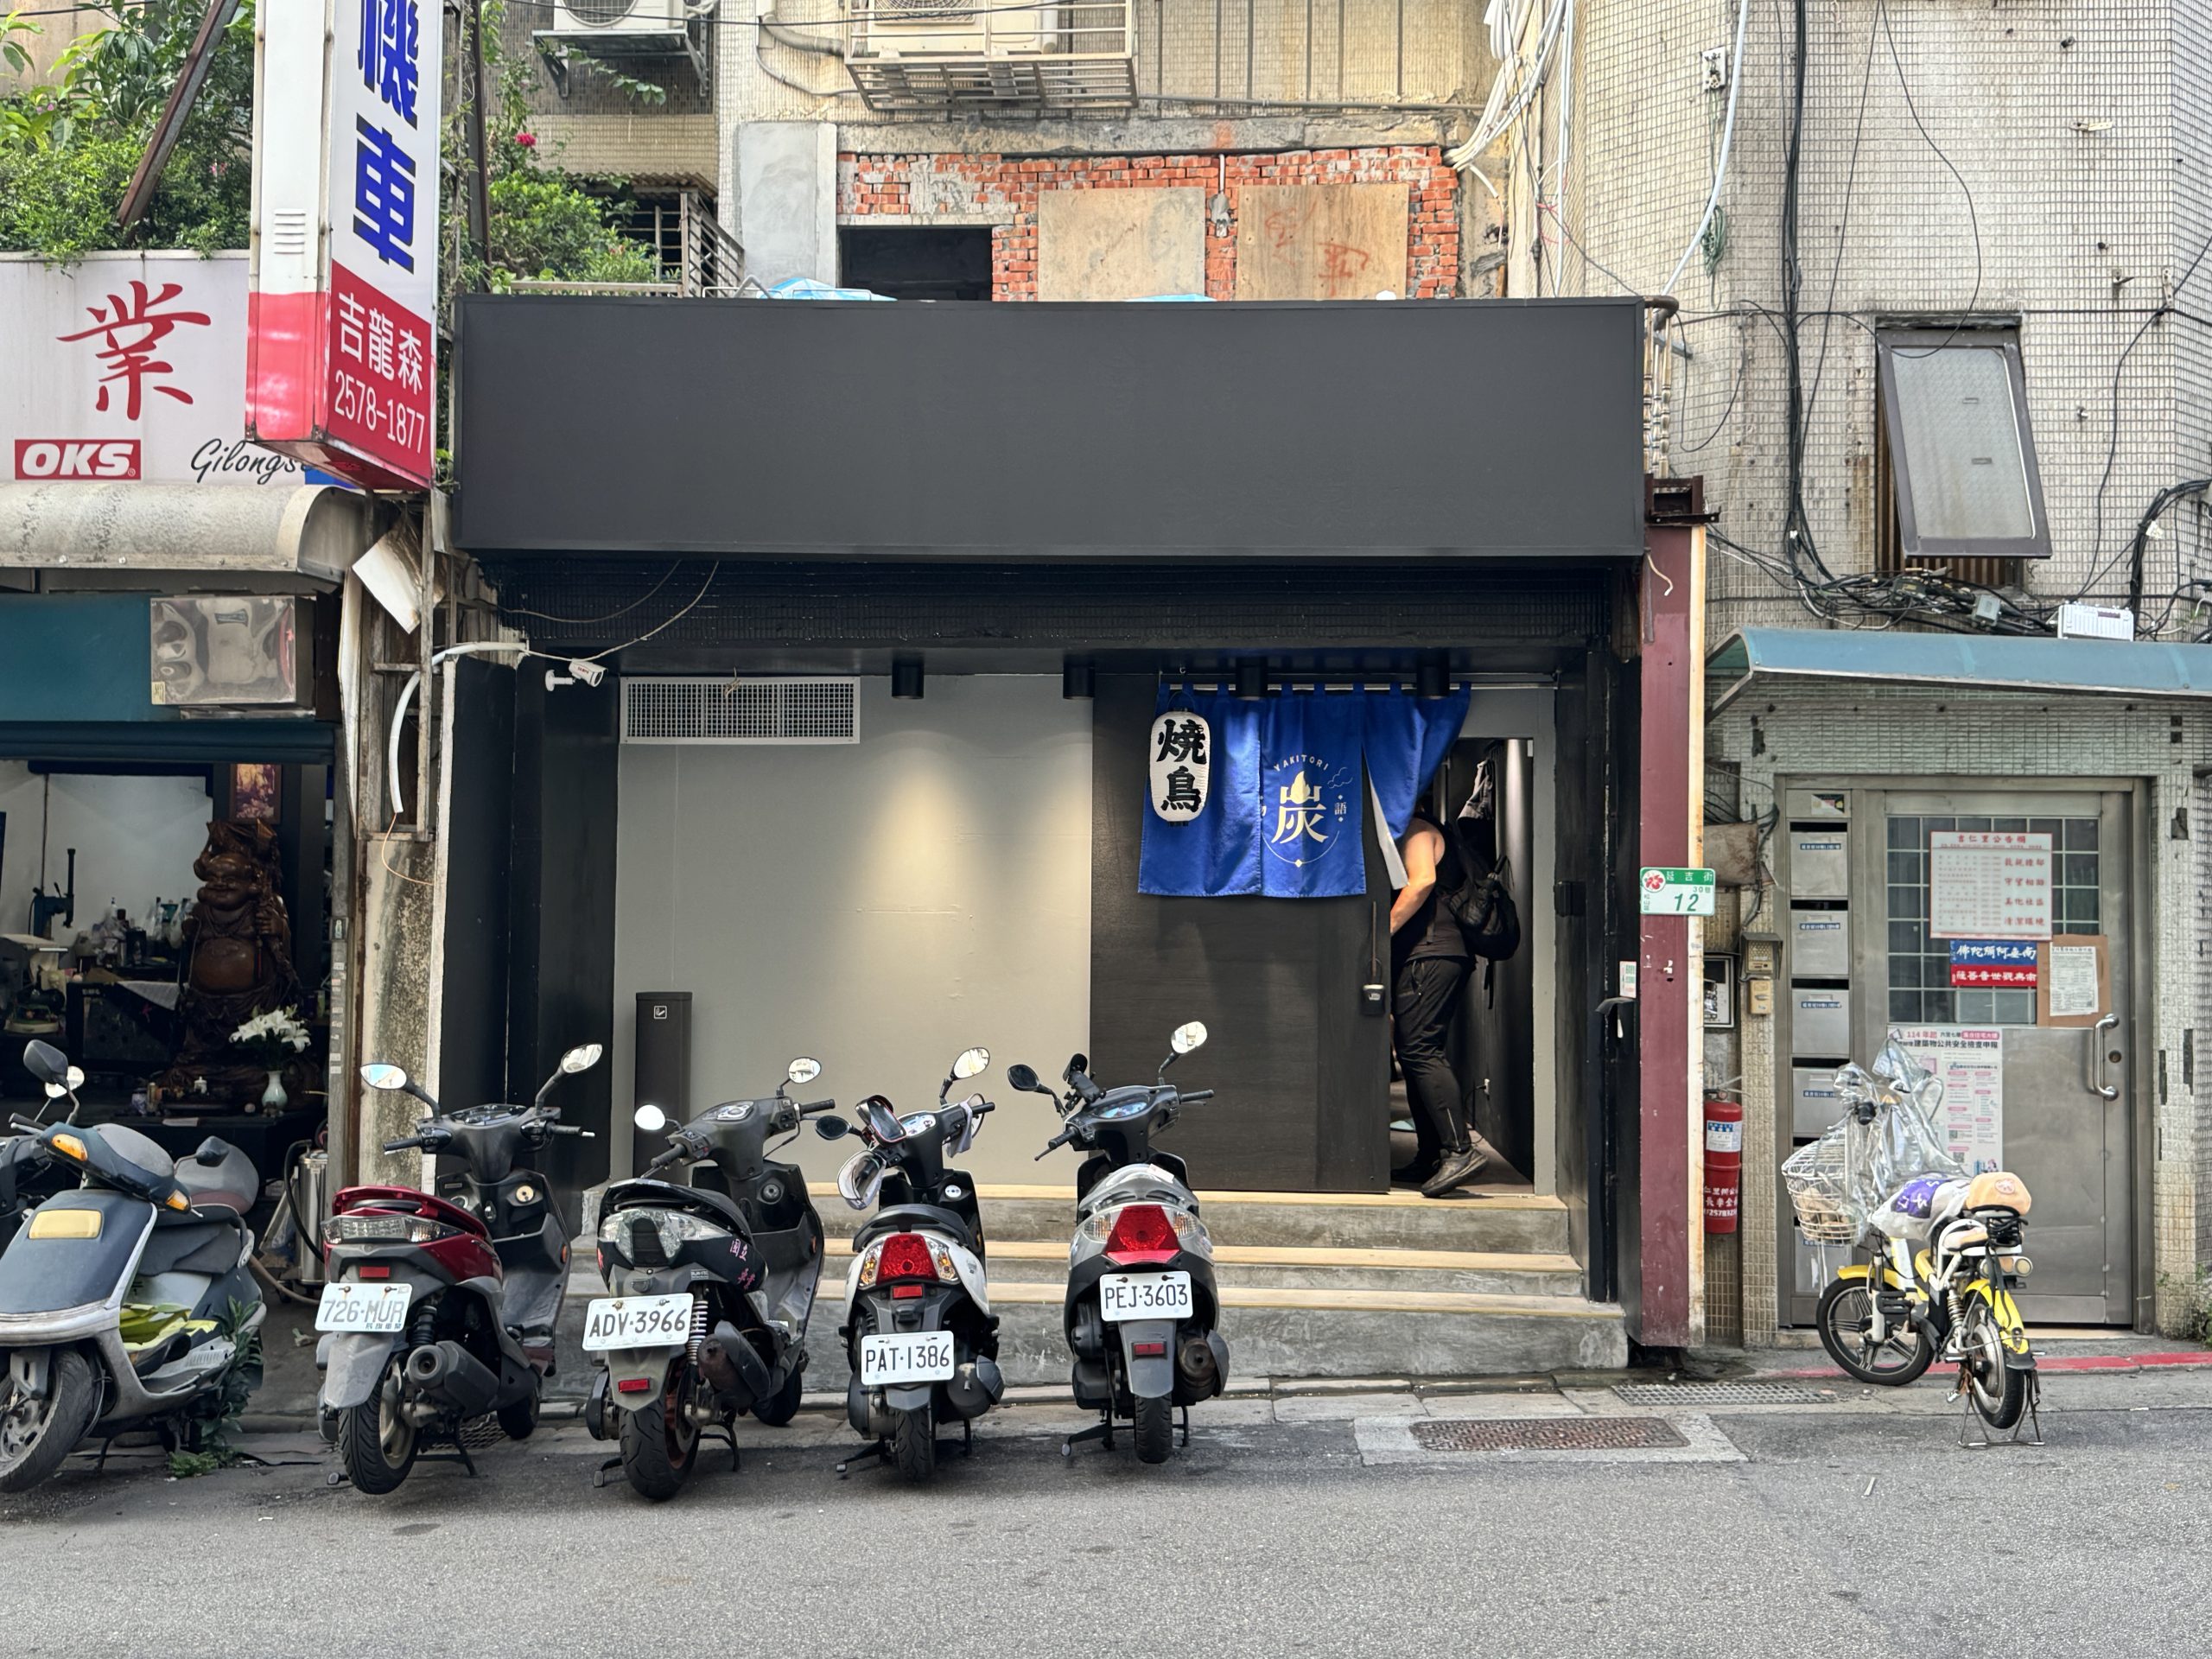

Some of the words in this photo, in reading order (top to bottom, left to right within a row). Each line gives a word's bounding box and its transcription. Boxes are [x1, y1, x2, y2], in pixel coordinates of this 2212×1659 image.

[57, 280, 211, 421] 業
[338, 292, 423, 396] 吉龍森
[334, 369, 426, 454] 2578-1877
[22, 443, 132, 476] OKS
[1274, 754, 1329, 772] YAKITORI
[1270, 771, 1329, 844] 炭
[1674, 893, 1699, 912] 12
